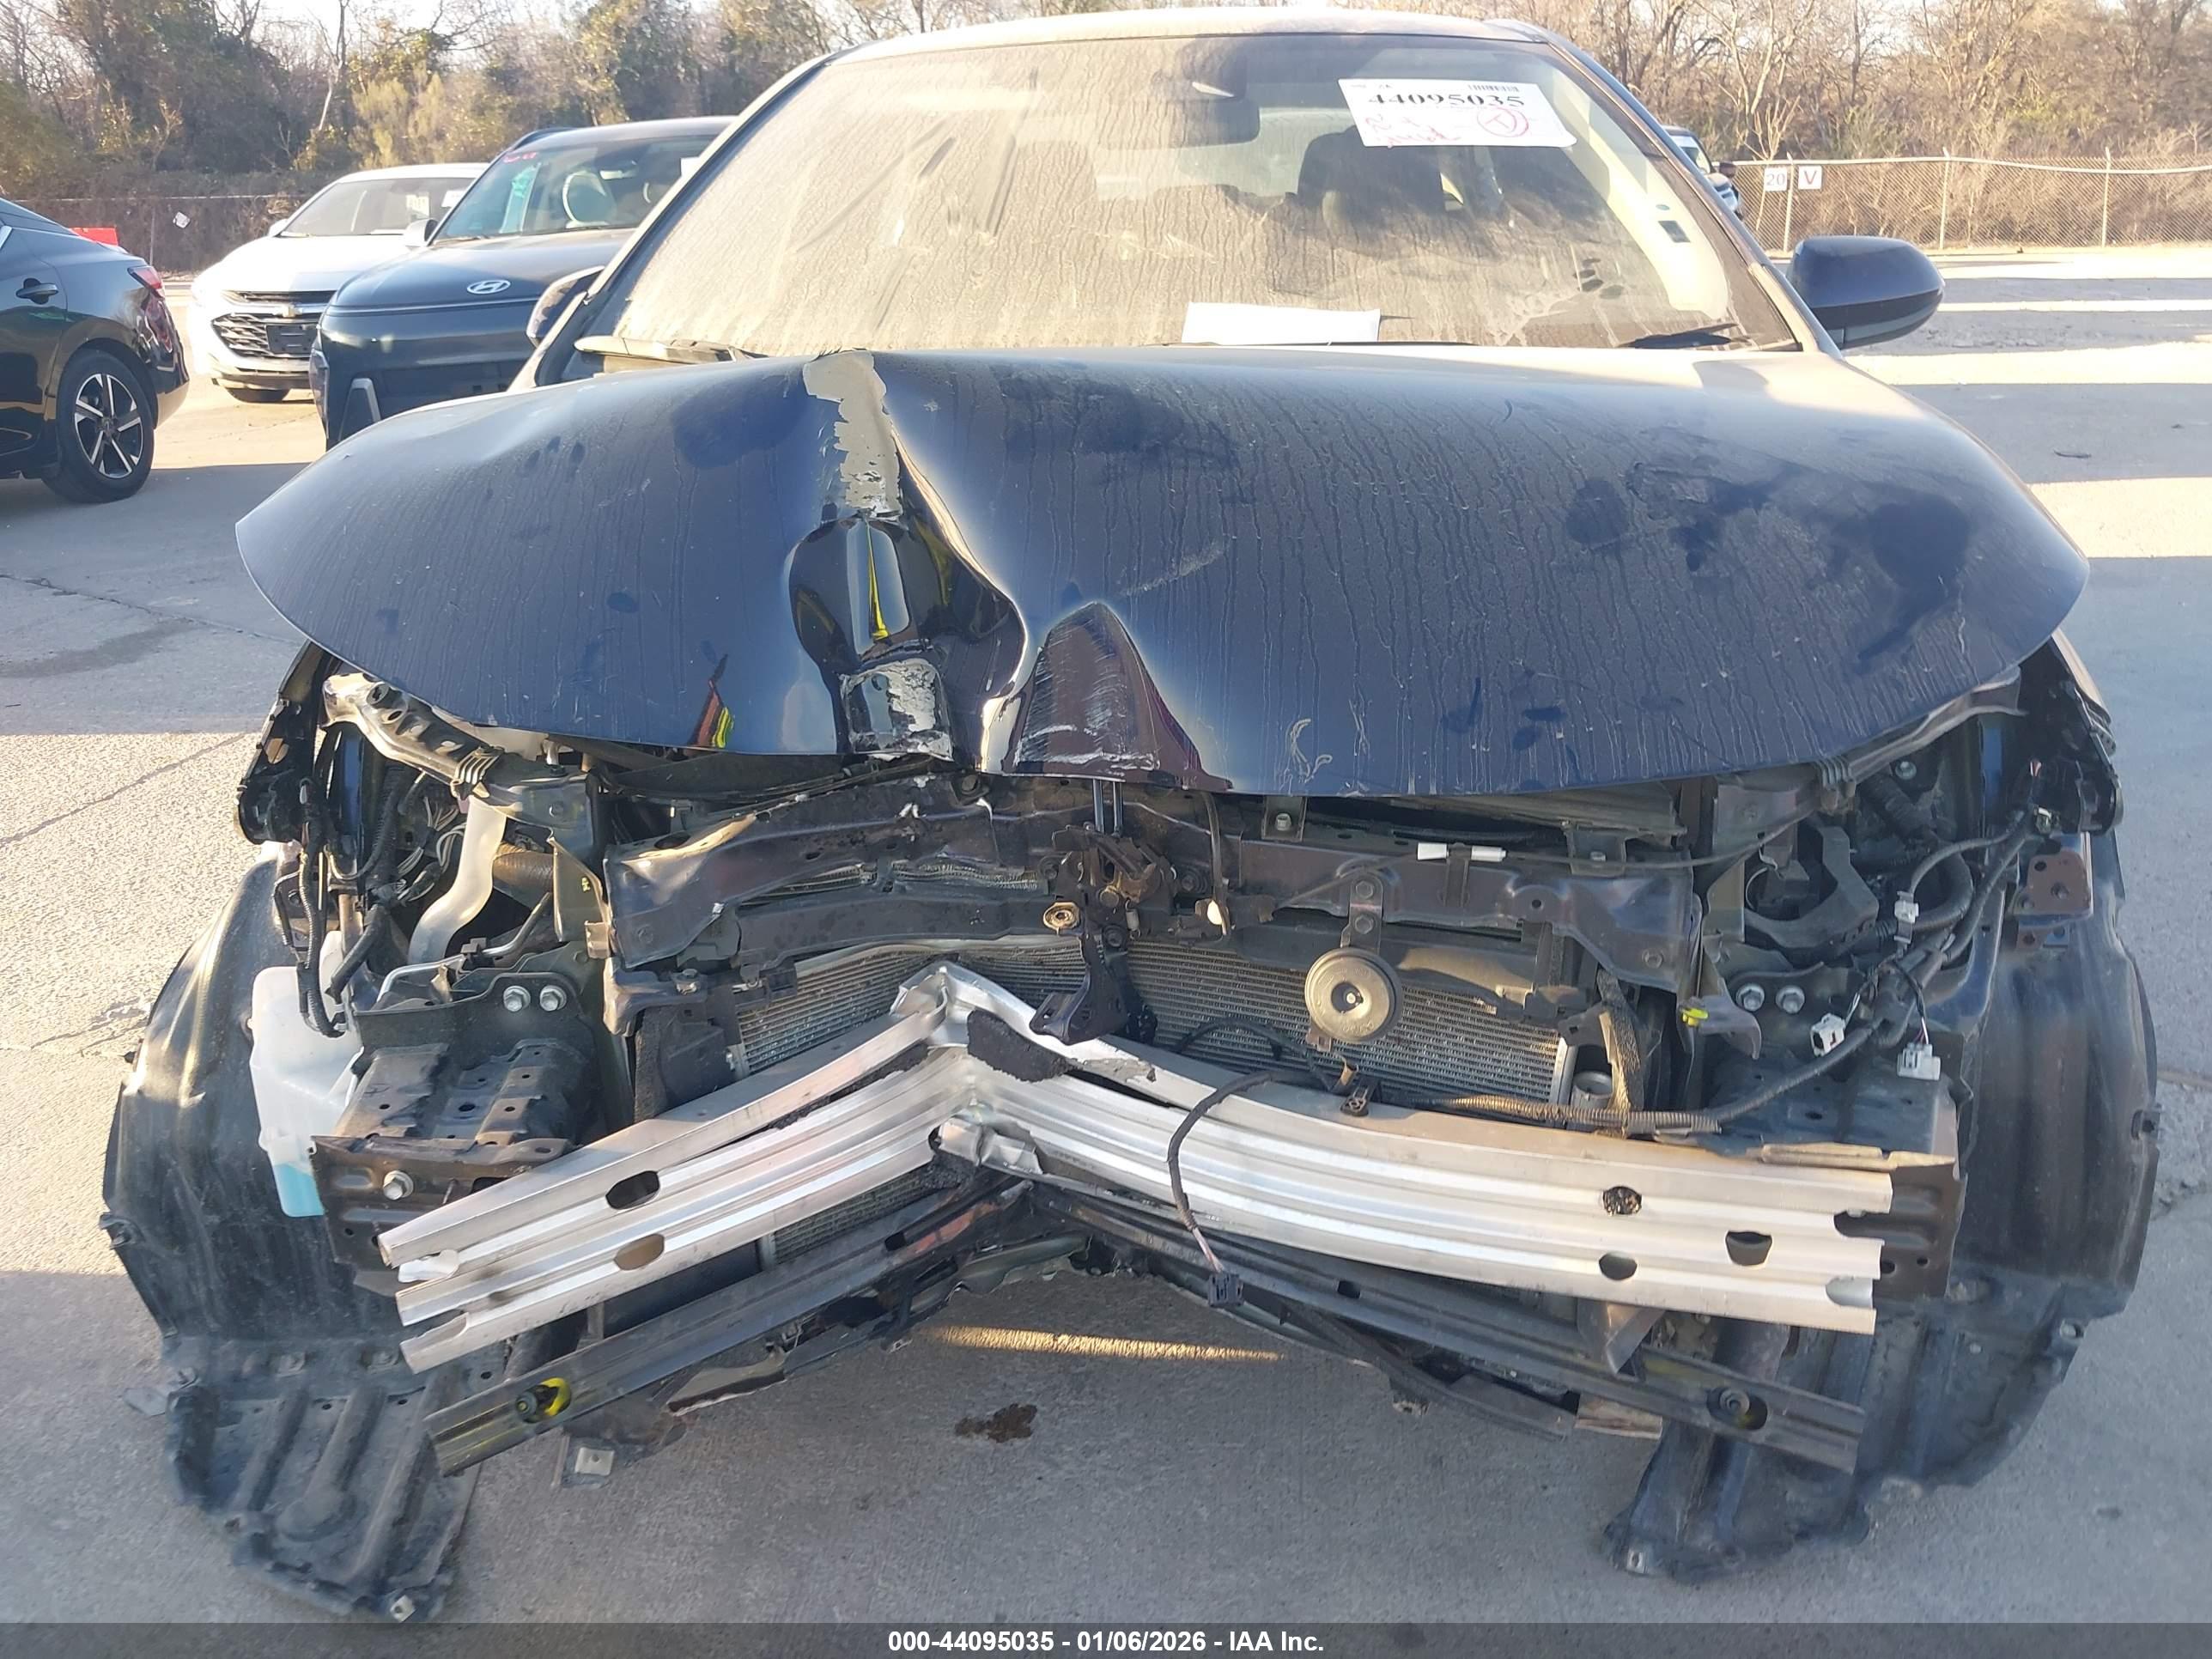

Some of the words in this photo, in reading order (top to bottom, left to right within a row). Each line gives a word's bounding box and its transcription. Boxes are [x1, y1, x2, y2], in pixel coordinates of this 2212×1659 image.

[1367, 93, 1526, 107] 44095035
[1765, 173, 1786, 186] 20
[1803, 169, 1818, 185] V
